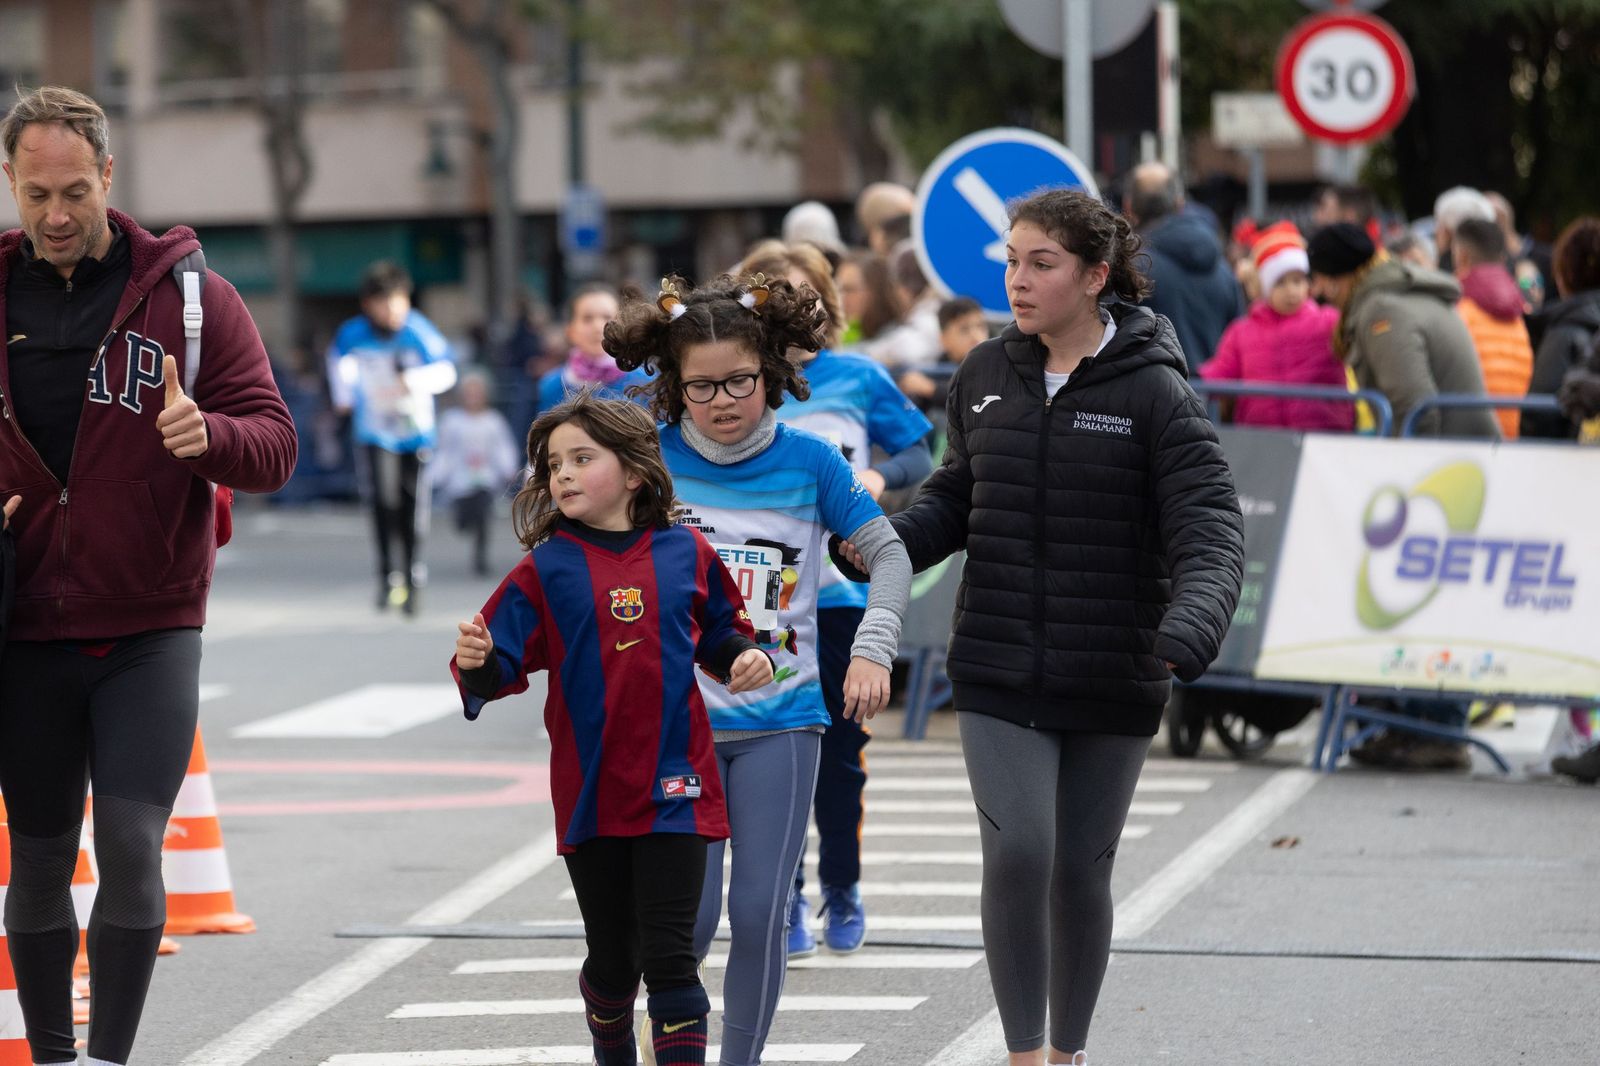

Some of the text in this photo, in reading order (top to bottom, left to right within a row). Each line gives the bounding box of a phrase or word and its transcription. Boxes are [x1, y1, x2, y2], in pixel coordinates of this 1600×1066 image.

[1310, 58, 1379, 102] 30
[1080, 421, 1132, 435] SALAMANCA
[1396, 536, 1576, 587] SETEL
